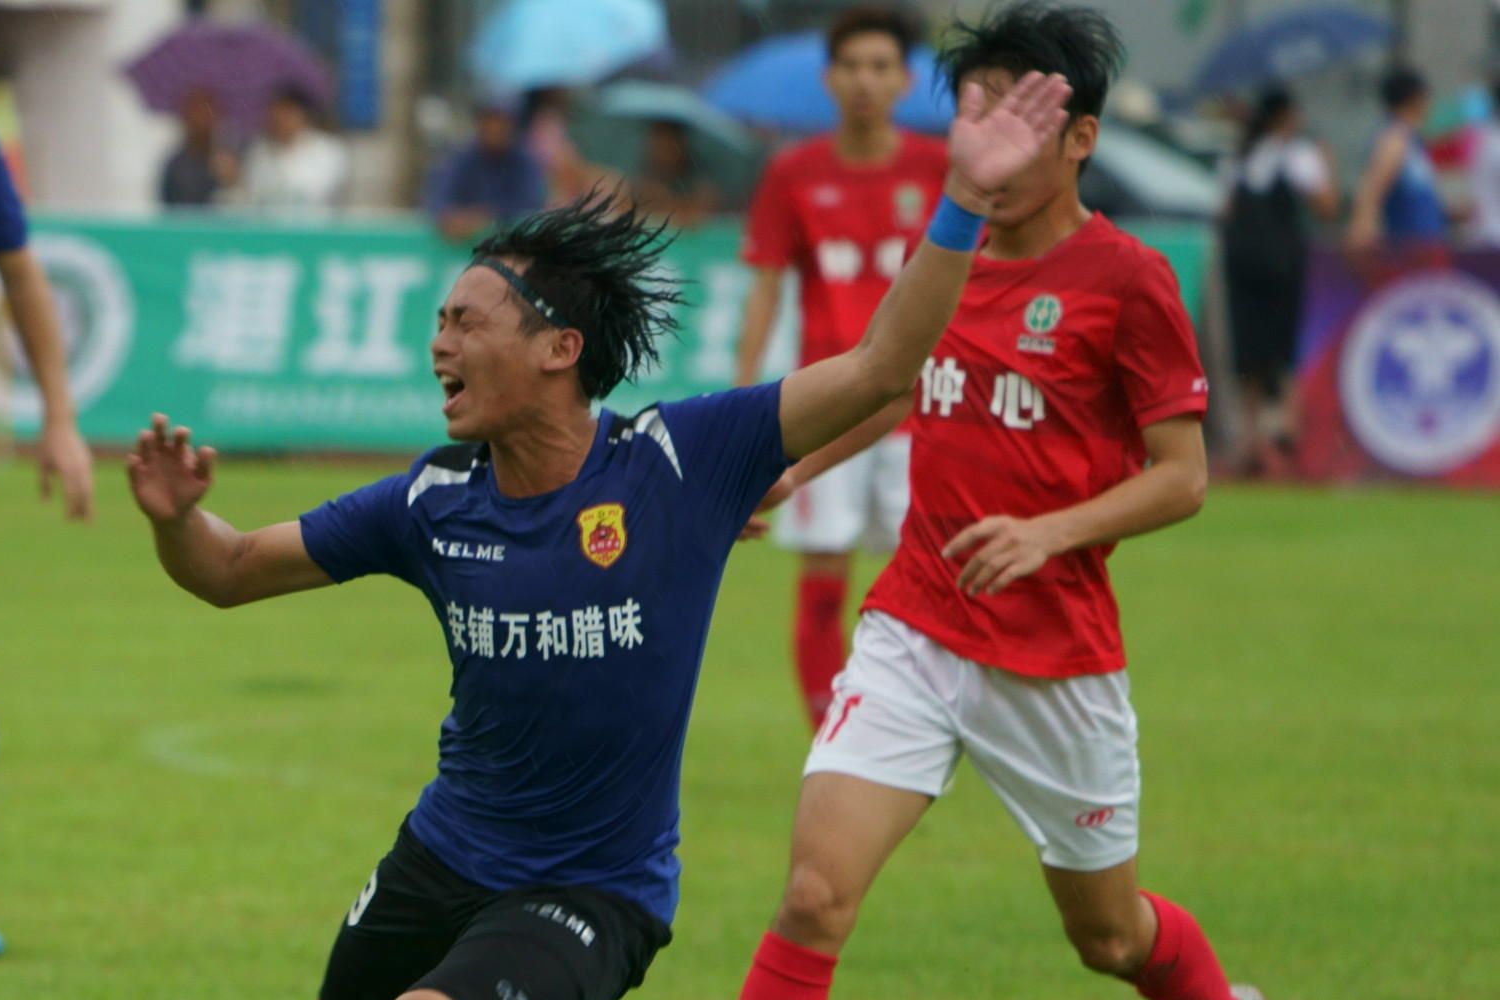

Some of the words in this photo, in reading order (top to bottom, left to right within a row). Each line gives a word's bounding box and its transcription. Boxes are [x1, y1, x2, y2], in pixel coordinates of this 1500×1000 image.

[432, 538, 505, 562] KELME
[447, 597, 644, 661] 安铺万和腊味
